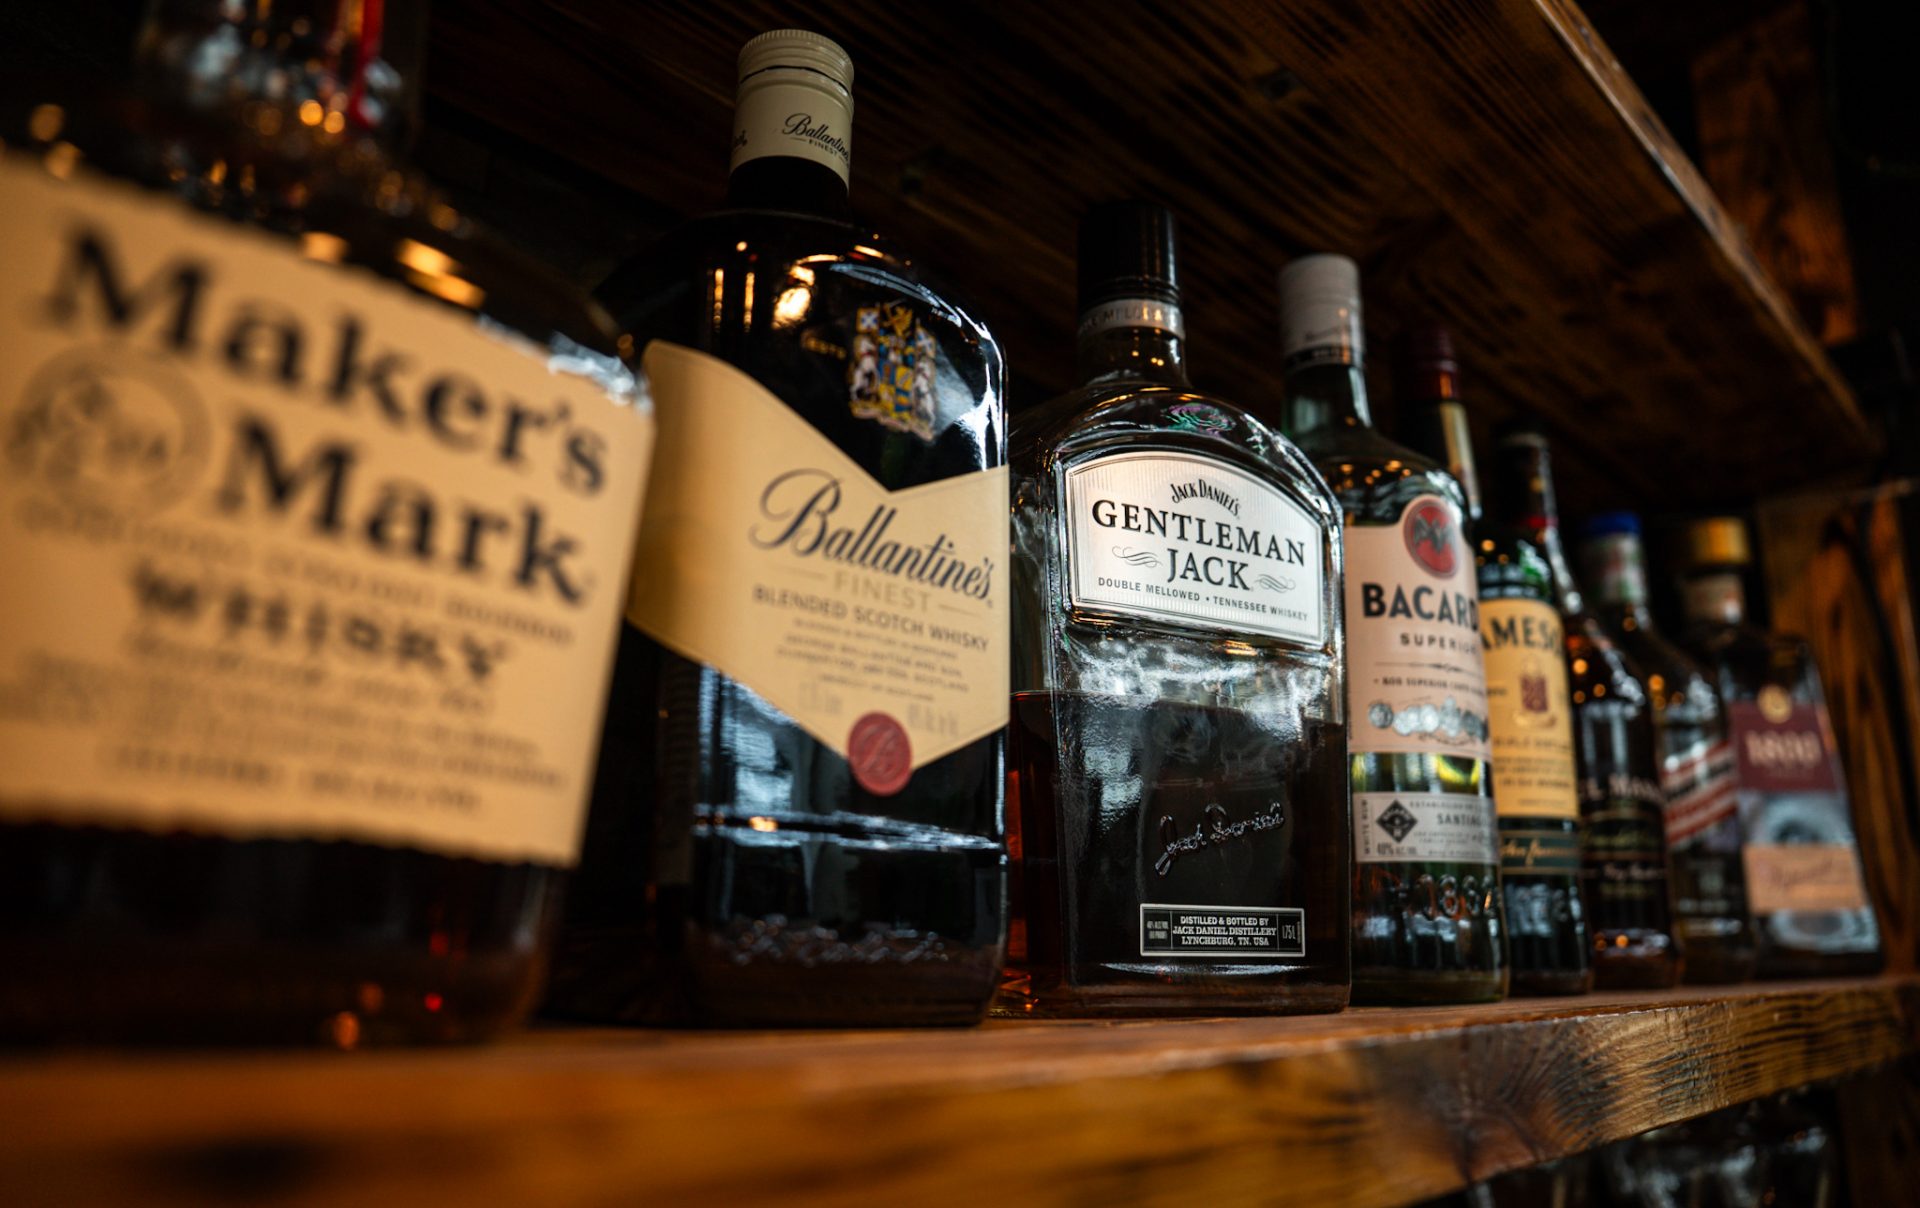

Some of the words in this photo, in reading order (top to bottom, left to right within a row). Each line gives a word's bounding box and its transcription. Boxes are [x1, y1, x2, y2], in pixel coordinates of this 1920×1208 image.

[809, 139, 838, 156] FINEST
[40, 221, 608, 496] Maker's
[214, 412, 587, 608] Mark
[1170, 481, 1197, 504] JACK
[749, 467, 995, 600] Ballantine's
[1092, 499, 1305, 567] GENTLEMAN
[1166, 548, 1250, 591] JACK
[833, 570, 932, 613] FINEST
[1098, 577, 1141, 592] DOUBLE
[1146, 584, 1200, 601] MELLOWED
[1213, 596, 1267, 613] TENNESSEE
[1270, 605, 1308, 622] WHISKEY
[1362, 582, 1479, 631] BACARD
[752, 583, 848, 620] BLENDED
[854, 604, 924, 637] SCOTCH
[929, 624, 989, 651] WHISKY
[1437, 812, 1487, 826] SANTIAG
[1172, 926, 1195, 934] JACK
[1196, 926, 1228, 935] DANIEL
[1229, 927, 1276, 935] DISTILLERY
[1180, 916, 1218, 925] DISTILLED
[1218, 916, 1225, 925] &
[1226, 917, 1258, 926] BOTTLED
[1259, 917, 1269, 926] BY
[1253, 936, 1270, 946] USA
